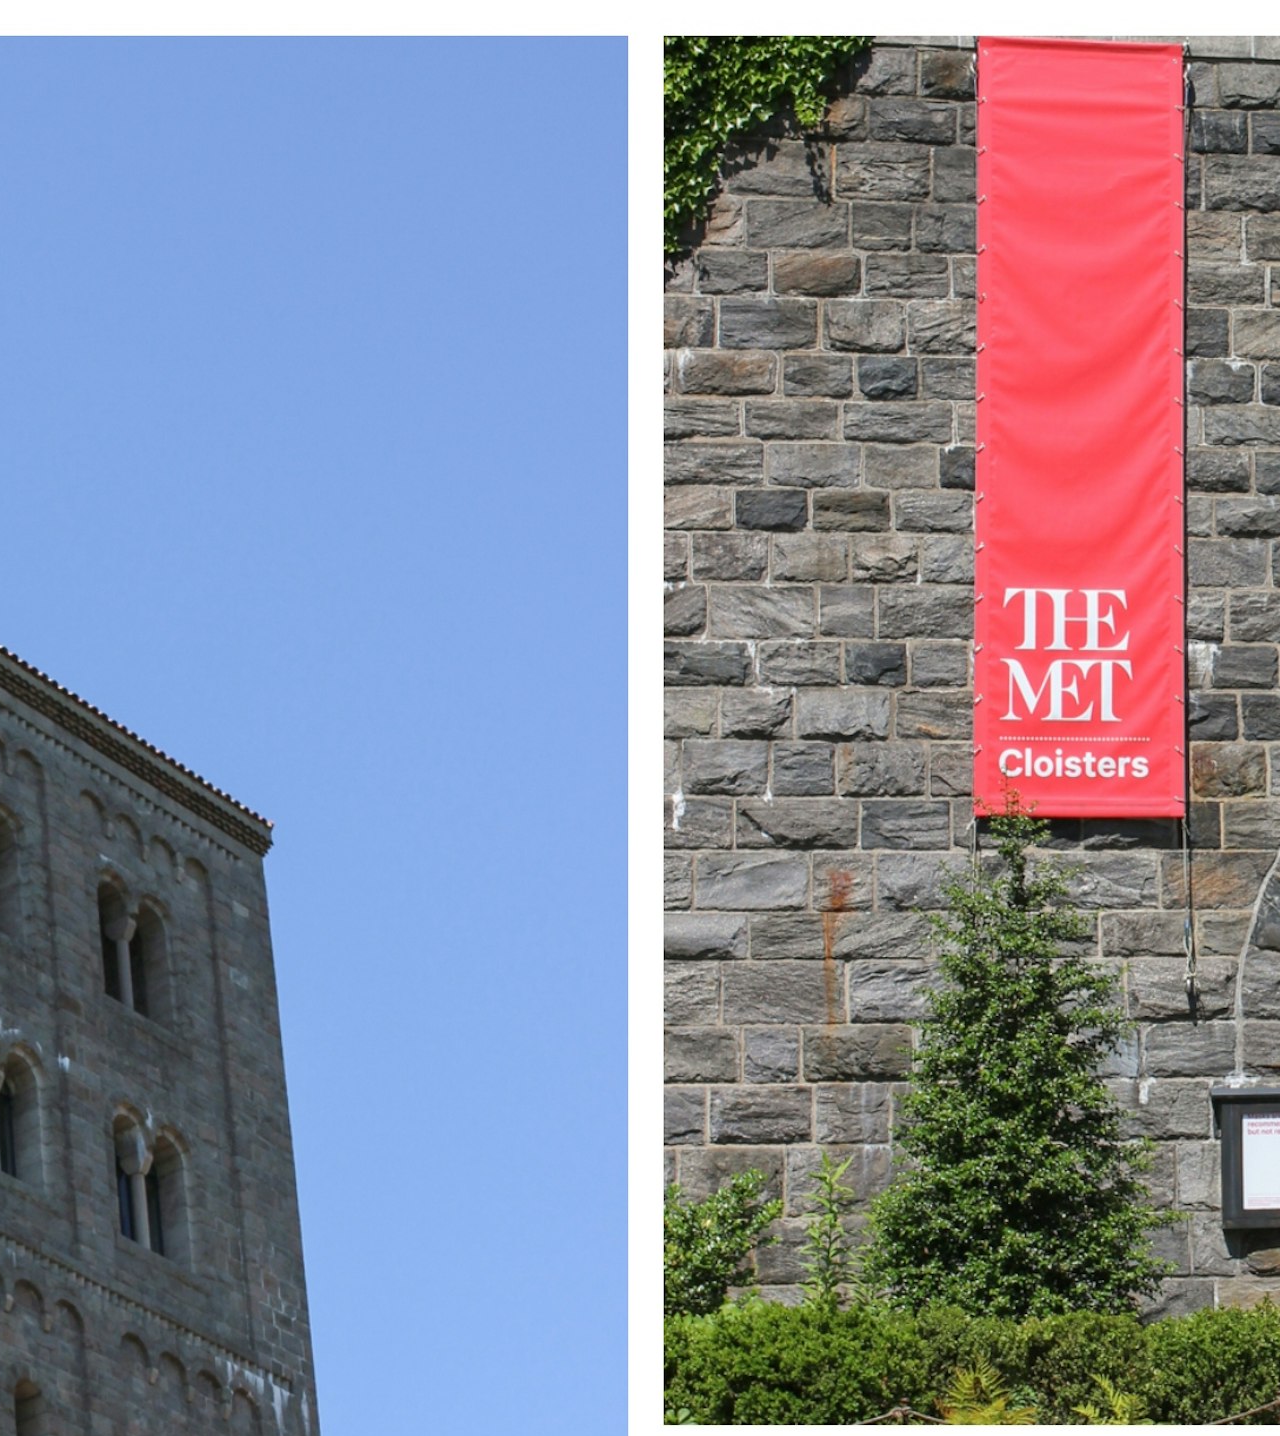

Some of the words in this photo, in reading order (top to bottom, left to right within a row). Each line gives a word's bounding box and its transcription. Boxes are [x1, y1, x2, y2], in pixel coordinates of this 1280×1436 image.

[1002, 587, 1130, 651] THE
[999, 657, 1133, 722] MET
[998, 747, 1150, 778] Cloisters
